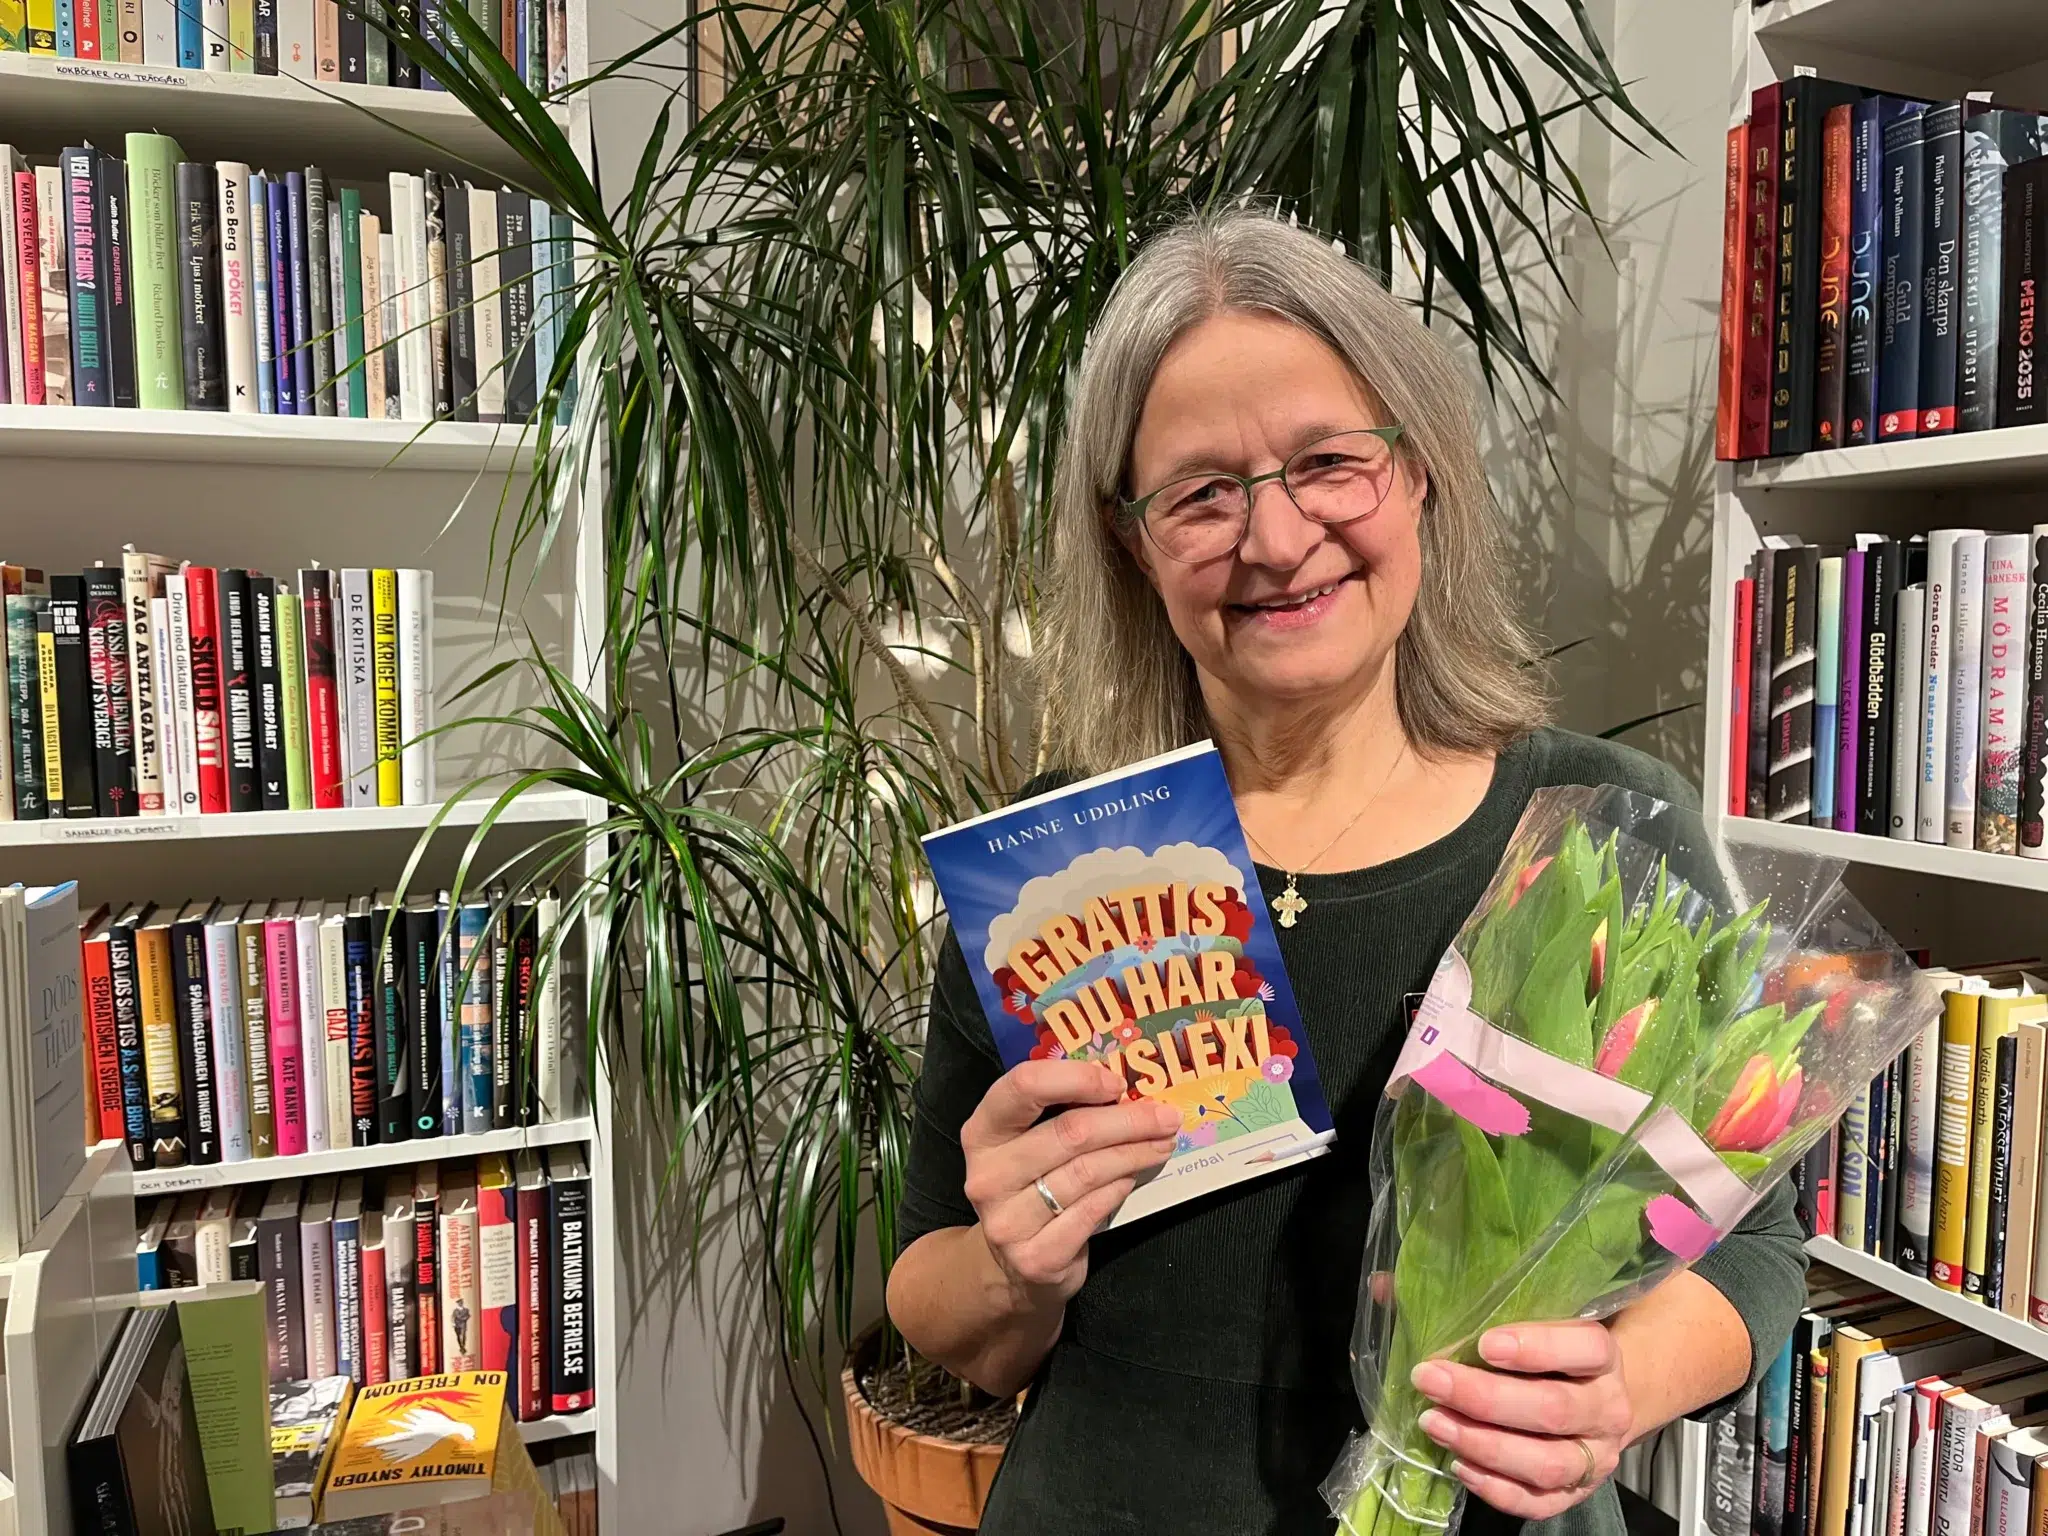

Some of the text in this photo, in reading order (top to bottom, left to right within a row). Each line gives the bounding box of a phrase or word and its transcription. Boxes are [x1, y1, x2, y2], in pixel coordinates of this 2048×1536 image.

[56, 66, 186, 86] KOKBÖCKER OCH TRÄDGÅRD
[20, 182, 34, 265] MARIA SVELAND
[516, 214, 524, 232] Eva
[1892, 165, 1905, 237] Philip Pullman
[1933, 154, 1946, 228] Philip Pullman
[71, 156, 100, 369] VEM ÄR RÄDD FÖR GENUS? JUDITH BUTLER
[110, 195, 122, 306] Judith GENUSTRUBBEL
[152, 168, 166, 360] Böcker Richard Dawkins
[190, 201, 205, 325] Erik Wijk Ljus mörkret
[225, 178, 244, 317] Aase Berg SPÖKET
[311, 218, 325, 239] SIG
[1820, 235, 1840, 331] DUNE
[1850, 229, 1874, 329] DUNE
[1882, 253, 1901, 346] kompassen
[1895, 279, 1913, 325] Guld
[1924, 266, 1938, 317] eggen
[1934, 239, 1956, 336] Den skarpa
[486, 324, 494, 348] ILLOUZ
[1964, 329, 1979, 383] UTPOST
[2016, 279, 2035, 399] METRO 2035
[313, 587, 322, 600] Jan
[1786, 565, 1797, 599] HENRIK
[1991, 560, 2014, 570] TINA
[133, 595, 148, 636] JAG
[351, 594, 366, 685] DE KRITISKA
[376, 613, 394, 635] OM
[1755, 607, 1764, 645] BOHMAN
[1873, 594, 1881, 626] ELENSKY
[89, 627, 112, 749] KRIG MOT SVERIGE
[107, 619, 130, 756] RYSSLANDS HEMLIGA
[172, 592, 190, 712] Driva med diktaturer
[228, 591, 253, 769] LINDA FAKTURA LUFT
[256, 593, 278, 750] JOAKIM MEDIN KURDSPÅRET
[377, 641, 396, 693] KRIGET
[412, 634, 421, 681] MEZRICH
[1867, 632, 1885, 719] Glödbädden
[1923, 583, 1942, 784] Göran Greider Nu när man död
[1952, 553, 1970, 784] Hanna Hallgren Hallelujaflickorna
[2028, 583, 2048, 775] Cecilia Hansson Kafkalungan
[191, 635, 222, 769] SKULDSATT
[379, 698, 397, 761] KOMMER
[22, 742, 33, 783] HELVETE!
[986, 785, 1172, 855] HANNE UDDLING
[384, 963, 394, 984] GRILL
[1007, 882, 1227, 994] GRATTIS
[110, 940, 138, 1047] LISA DOS SANTOS
[247, 998, 263, 1017] DET
[326, 1008, 348, 1042] GAZA
[1042, 950, 1240, 1052] DU HAR
[92, 976, 121, 1113] SEPARATISMEN SVERIGE
[189, 983, 206, 1081] SPANINGSLEDAREN
[248, 1020, 266, 1082] EKONOMISKA
[1096, 1014, 1271, 1101] SLEXI
[197, 1090, 214, 1134] RINKEBY
[254, 1084, 270, 1115] KÖNET
[281, 1056, 299, 1126] KATE MANNE
[351, 1065, 375, 1117] LAND
[1911, 1055, 1922, 1104] ARVOLA
[1976, 1046, 1993, 1126] Vigdis Hjorth
[1176, 1152, 1225, 1177] verbal
[1937, 1042, 1971, 1232] VIGDIS HJORTH Om bara
[164, 1177, 204, 1188] DEBATT
[311, 1242, 321, 1271] MALIN
[349, 1261, 359, 1298] MELLAN
[447, 1217, 461, 1300] INFORMATIONSKRIG
[460, 1244, 474, 1271] VINNA
[562, 1220, 583, 1301] BALTIKUMS
[274, 1278, 290, 1368] DRAMA UTAN SLUT
[337, 1240, 351, 1361] MOHAMMAD FAZLHASHEMI
[391, 1287, 406, 1361] HAMAS: TERROR
[370, 1331, 384, 1367] Irans
[562, 1304, 583, 1377] BEFRIELSE
[364, 1373, 501, 1401] ON FREEDOM
[1792, 1353, 1804, 1430] GIULIANO EMPOLI
[332, 1461, 487, 1488] TIMOTHY SNYDER
[1715, 1419, 1738, 1514] PÅ LJUS
[1938, 1418, 1954, 1503] MARTINOVITJ
[1953, 1426, 1966, 1473] VIKTOR
